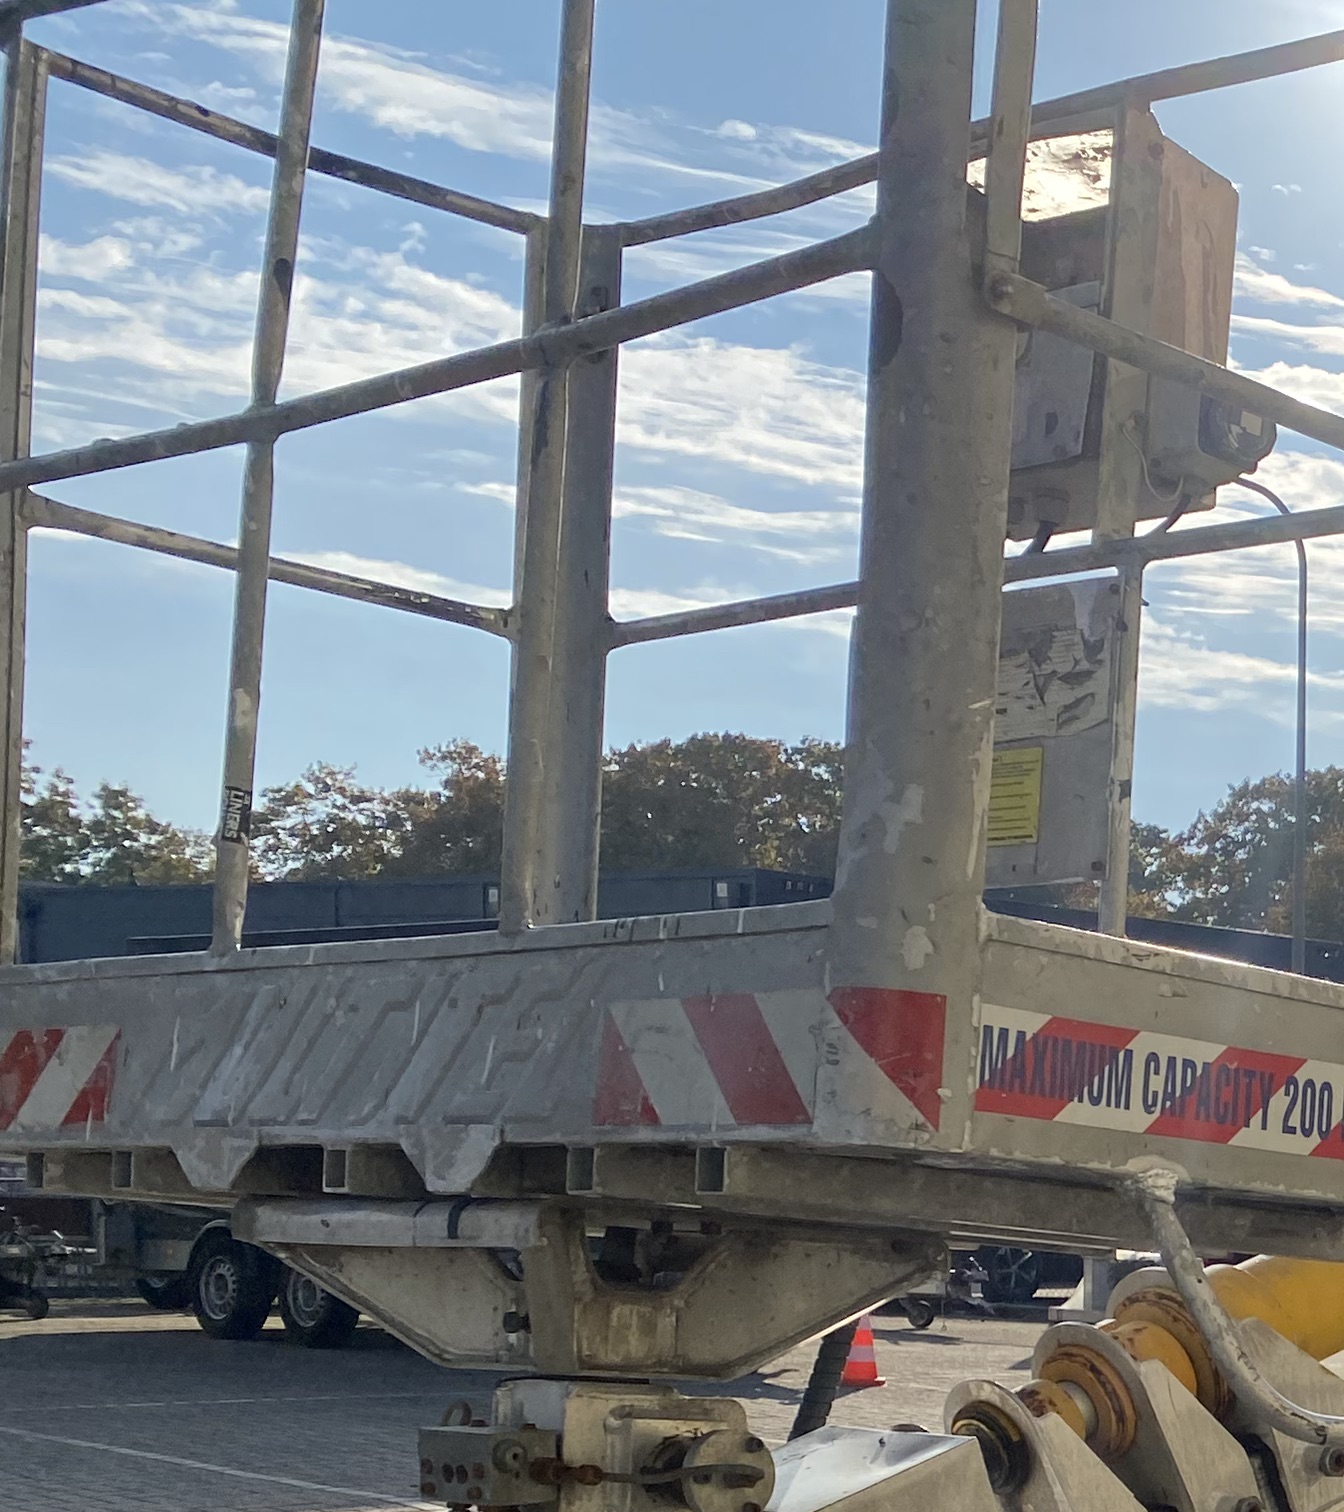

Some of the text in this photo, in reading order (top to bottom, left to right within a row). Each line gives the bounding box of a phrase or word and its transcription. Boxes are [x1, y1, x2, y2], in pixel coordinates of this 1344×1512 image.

[980, 1024, 1133, 1111] MAXIMUM
[1142, 1051, 1275, 1132] CAPACITY
[1282, 1076, 1334, 1141] 200
